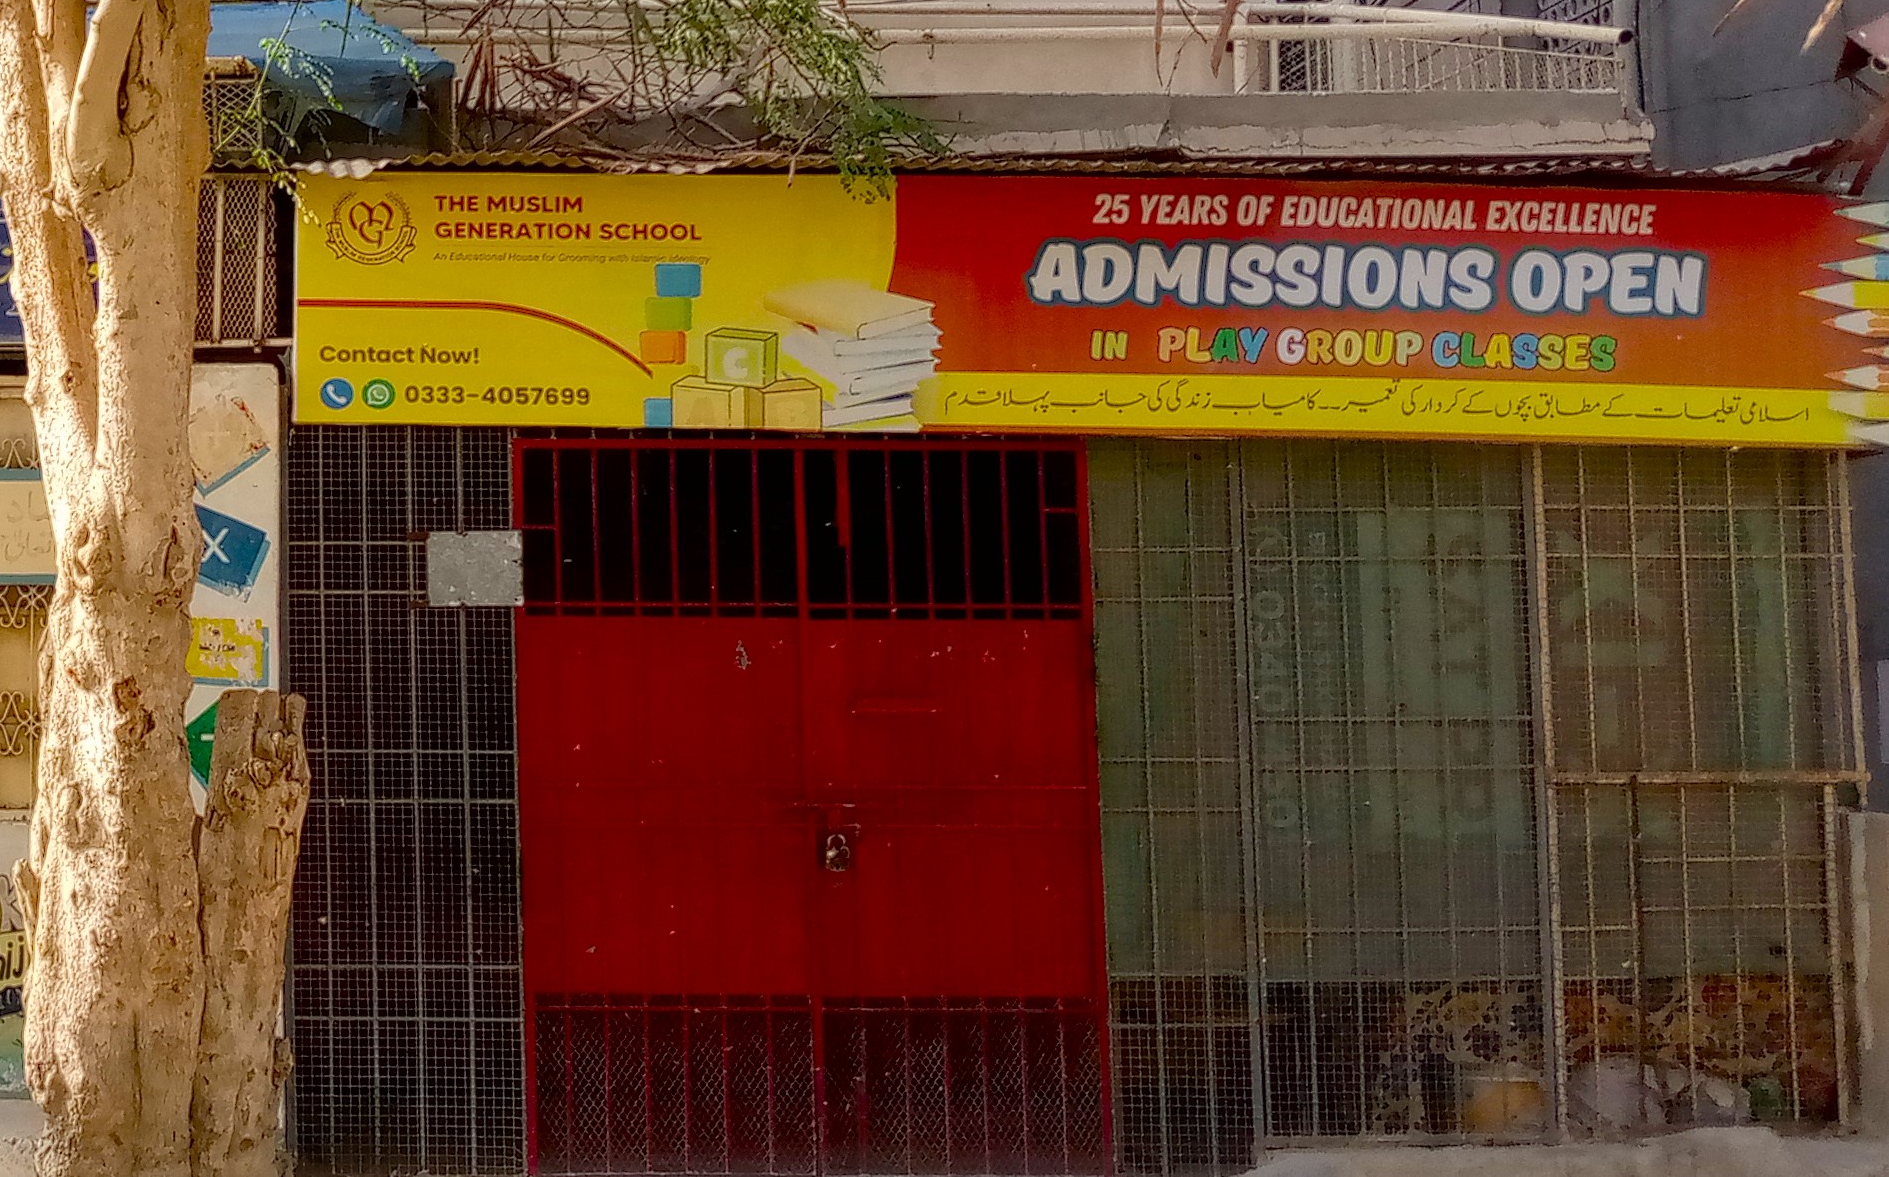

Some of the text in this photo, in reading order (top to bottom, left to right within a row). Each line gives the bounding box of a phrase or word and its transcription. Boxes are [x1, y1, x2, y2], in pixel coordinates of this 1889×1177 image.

[434, 195, 584, 213] THE MUSLIM
[1092, 194, 1656, 236] 25 YEARS OF EDUCATIONAL EXCELLENCE
[435, 223, 702, 241] GENERATION SCHOOL
[1031, 239, 1705, 316] ADMISSIONS OPEN
[319, 345, 480, 365] Contact Now!
[1090, 326, 1617, 372] IN PLAY GROUP CLASSES
[405, 384, 590, 406] 0333-4057699
